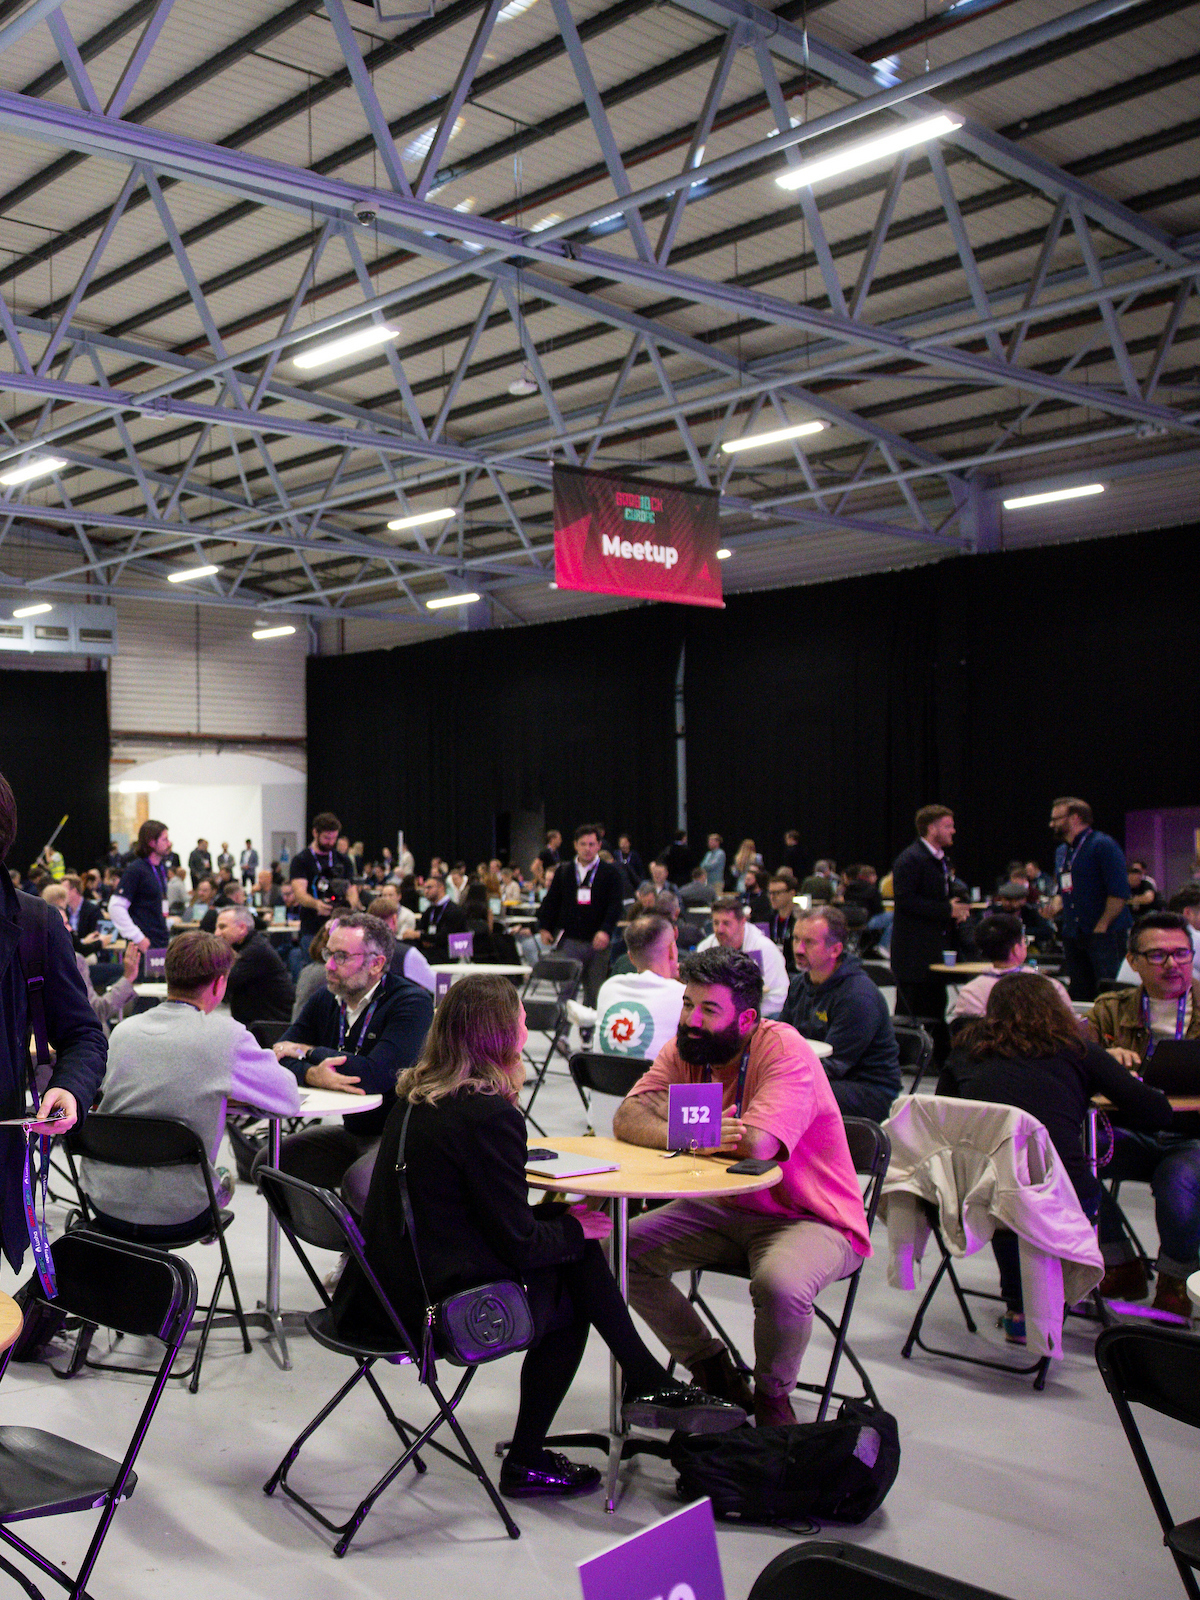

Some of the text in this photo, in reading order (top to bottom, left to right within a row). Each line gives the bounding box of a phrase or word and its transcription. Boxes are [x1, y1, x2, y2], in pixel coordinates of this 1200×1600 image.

[602, 534, 678, 569] Meetup
[682, 1106, 710, 1124] 132
[33, 1231, 41, 1247] Lusha
